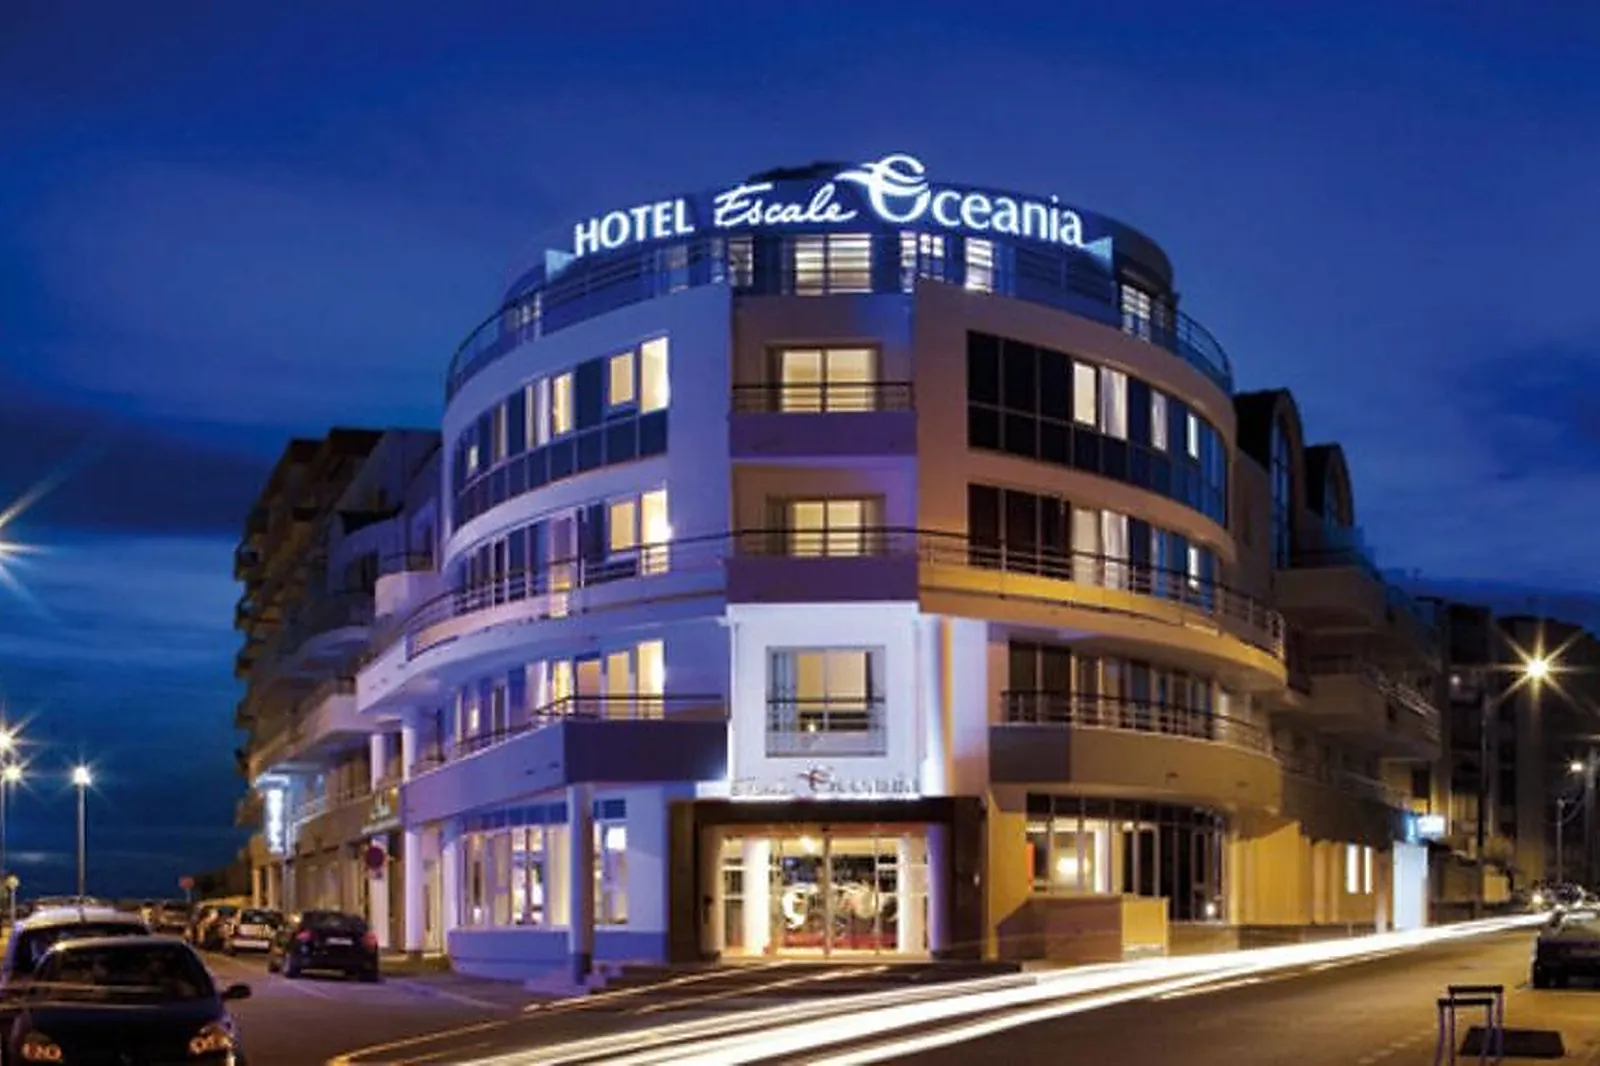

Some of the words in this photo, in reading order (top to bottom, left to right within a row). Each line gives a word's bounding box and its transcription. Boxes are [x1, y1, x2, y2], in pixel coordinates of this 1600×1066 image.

[574, 198, 694, 256] HOTEL
[713, 183, 858, 227] Escale
[836, 155, 1085, 248] Oceania
